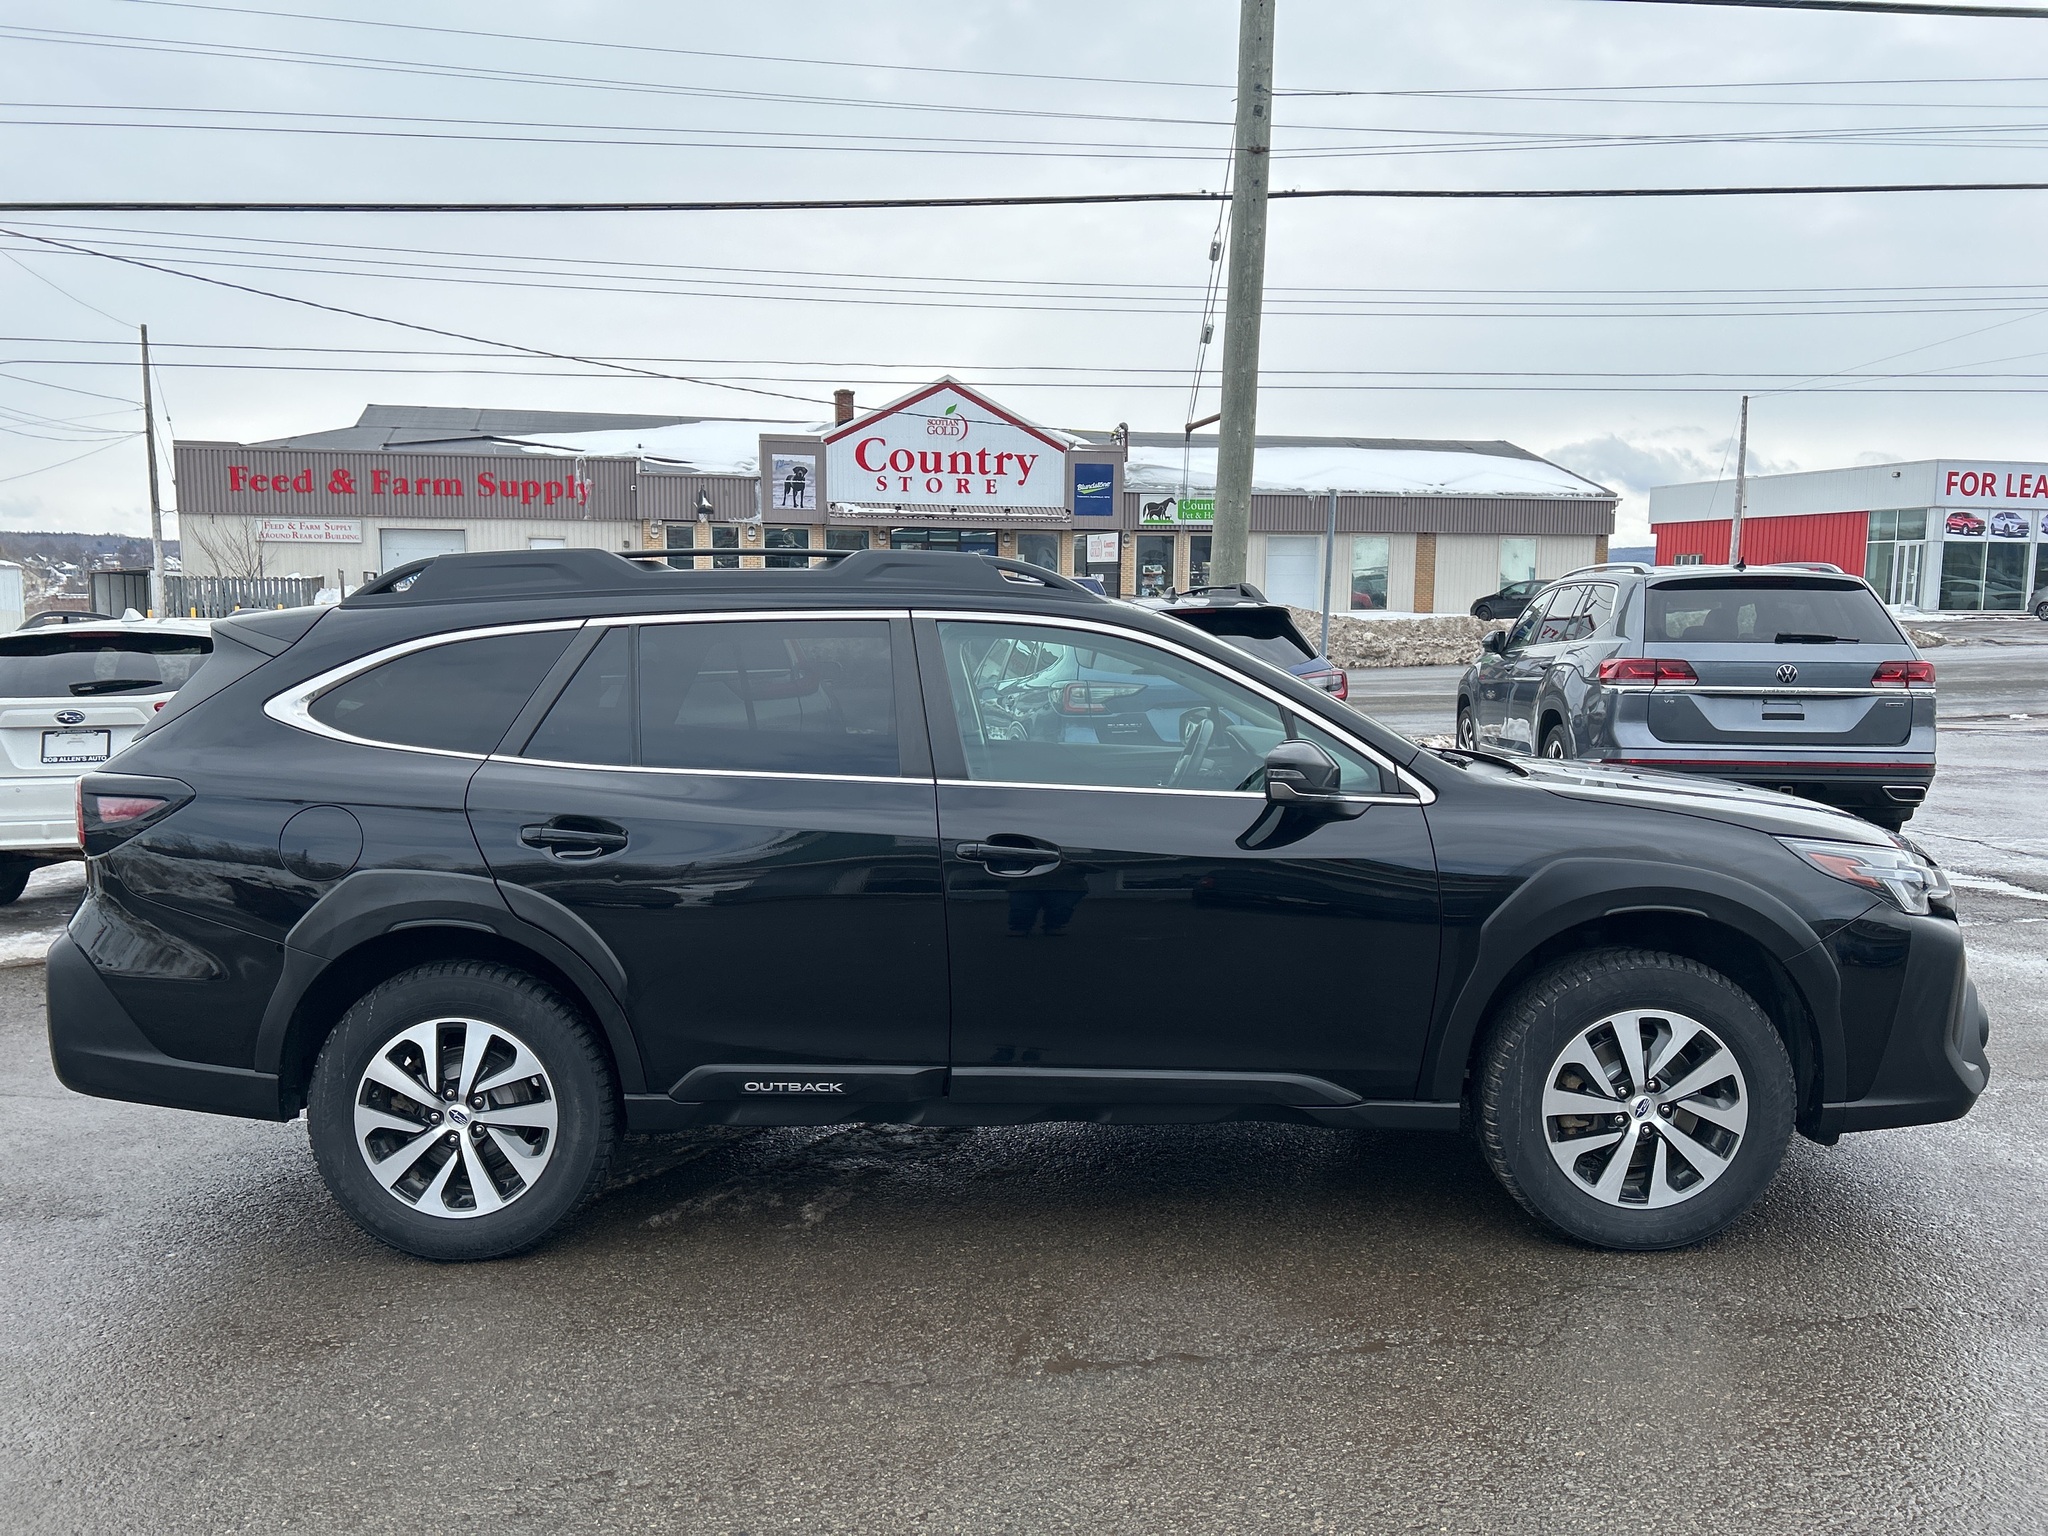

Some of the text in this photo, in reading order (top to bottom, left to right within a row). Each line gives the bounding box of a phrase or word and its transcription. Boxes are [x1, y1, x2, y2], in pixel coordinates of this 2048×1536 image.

[927, 418, 959, 426] SCOTIAN
[927, 426, 960, 436] GOLD
[855, 437, 1039, 486] Country
[228, 466, 594, 506] Feed & Farm Supply
[876, 475, 998, 495] STORE
[1945, 471, 2048, 499] FOR LEA
[1182, 511, 1193, 519] Pet
[1195, 511, 1202, 519] &
[287, 521, 296, 530] &
[299, 521, 320, 531] FARM
[324, 521, 353, 531] SUPPLY
[260, 531, 291, 539] AROUND
[292, 531, 312, 539] REAR
[325, 531, 360, 540] BUILDING
[744, 1082, 844, 1093] OUTBACK
